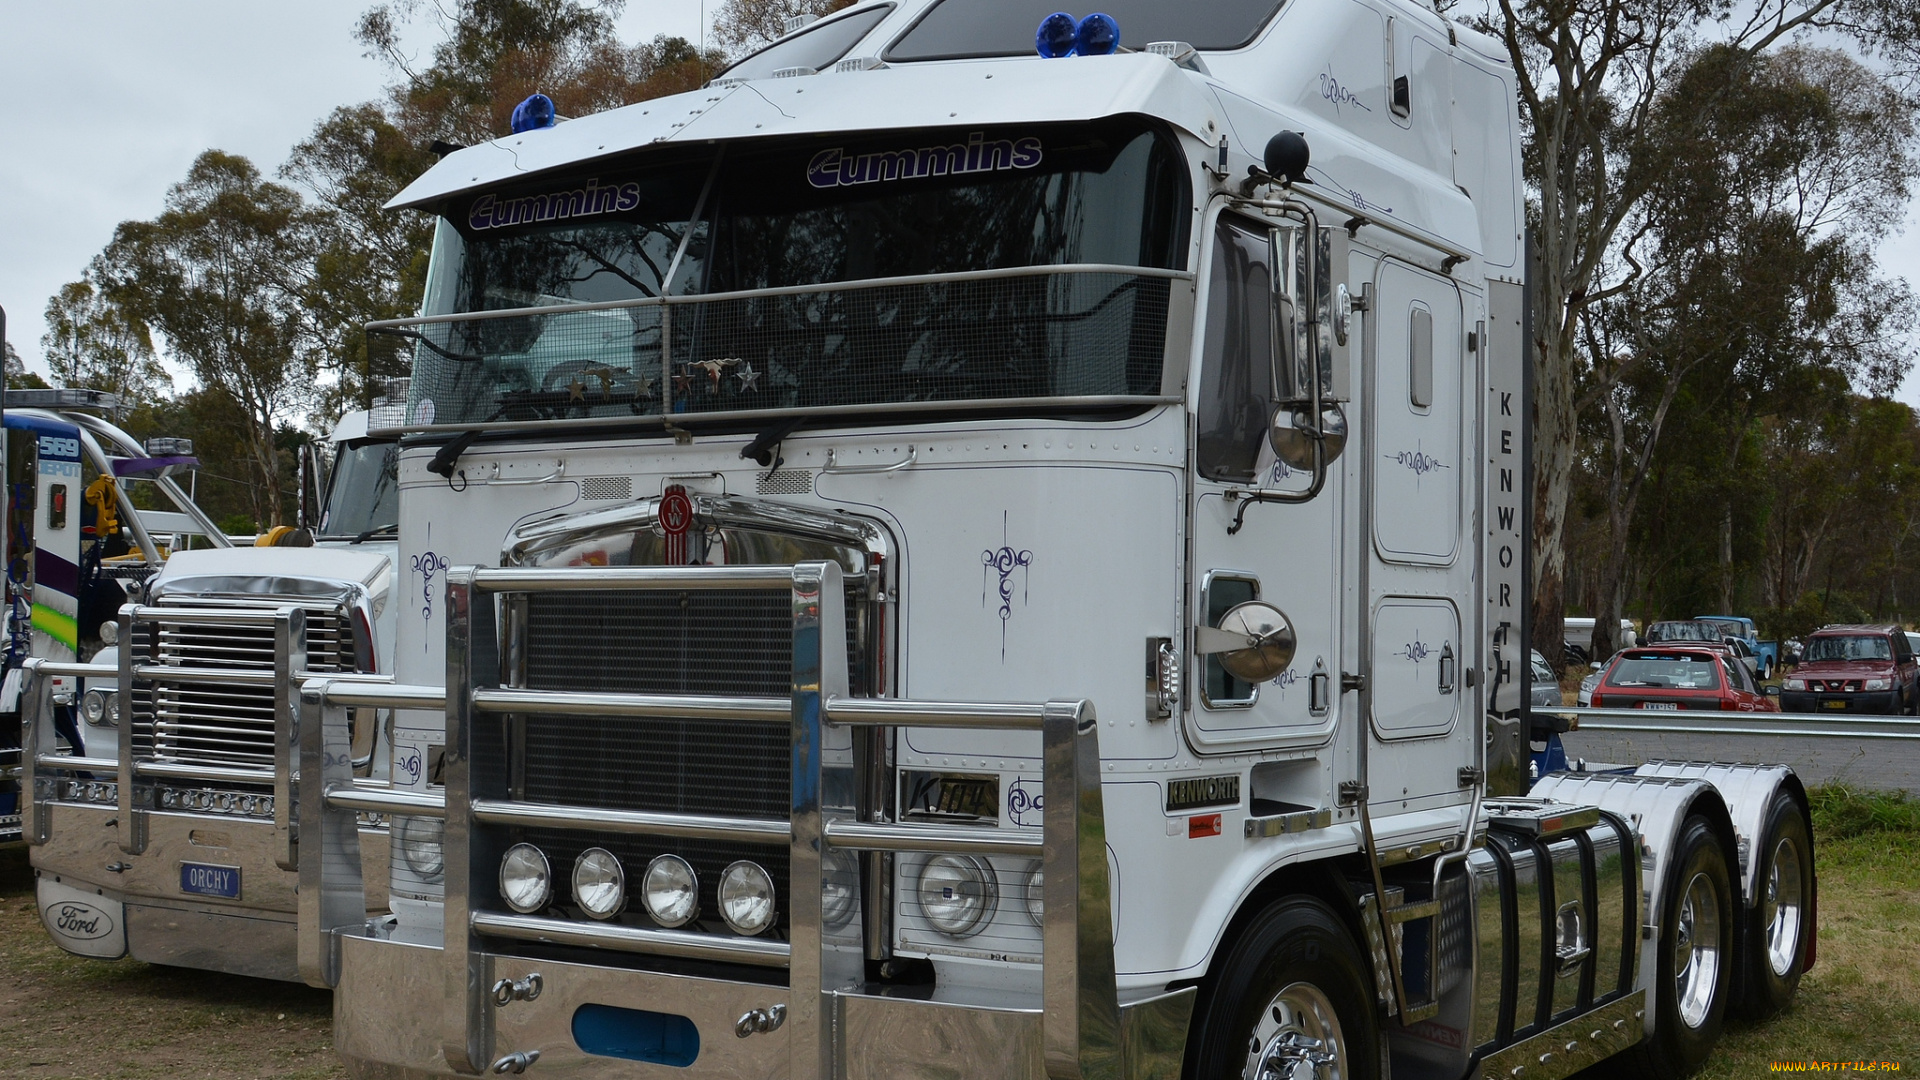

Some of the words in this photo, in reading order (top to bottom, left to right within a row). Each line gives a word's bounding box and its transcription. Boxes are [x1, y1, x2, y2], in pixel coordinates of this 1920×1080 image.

[807, 131, 1042, 188] Cummins
[469, 178, 640, 230] Cummins
[40, 436, 79, 457] 569
[1498, 391, 1515, 684] KENWORTH
[1169, 776, 1240, 804] KENWORTH
[190, 868, 230, 890] ORCHY
[58, 905, 99, 934] Ford
